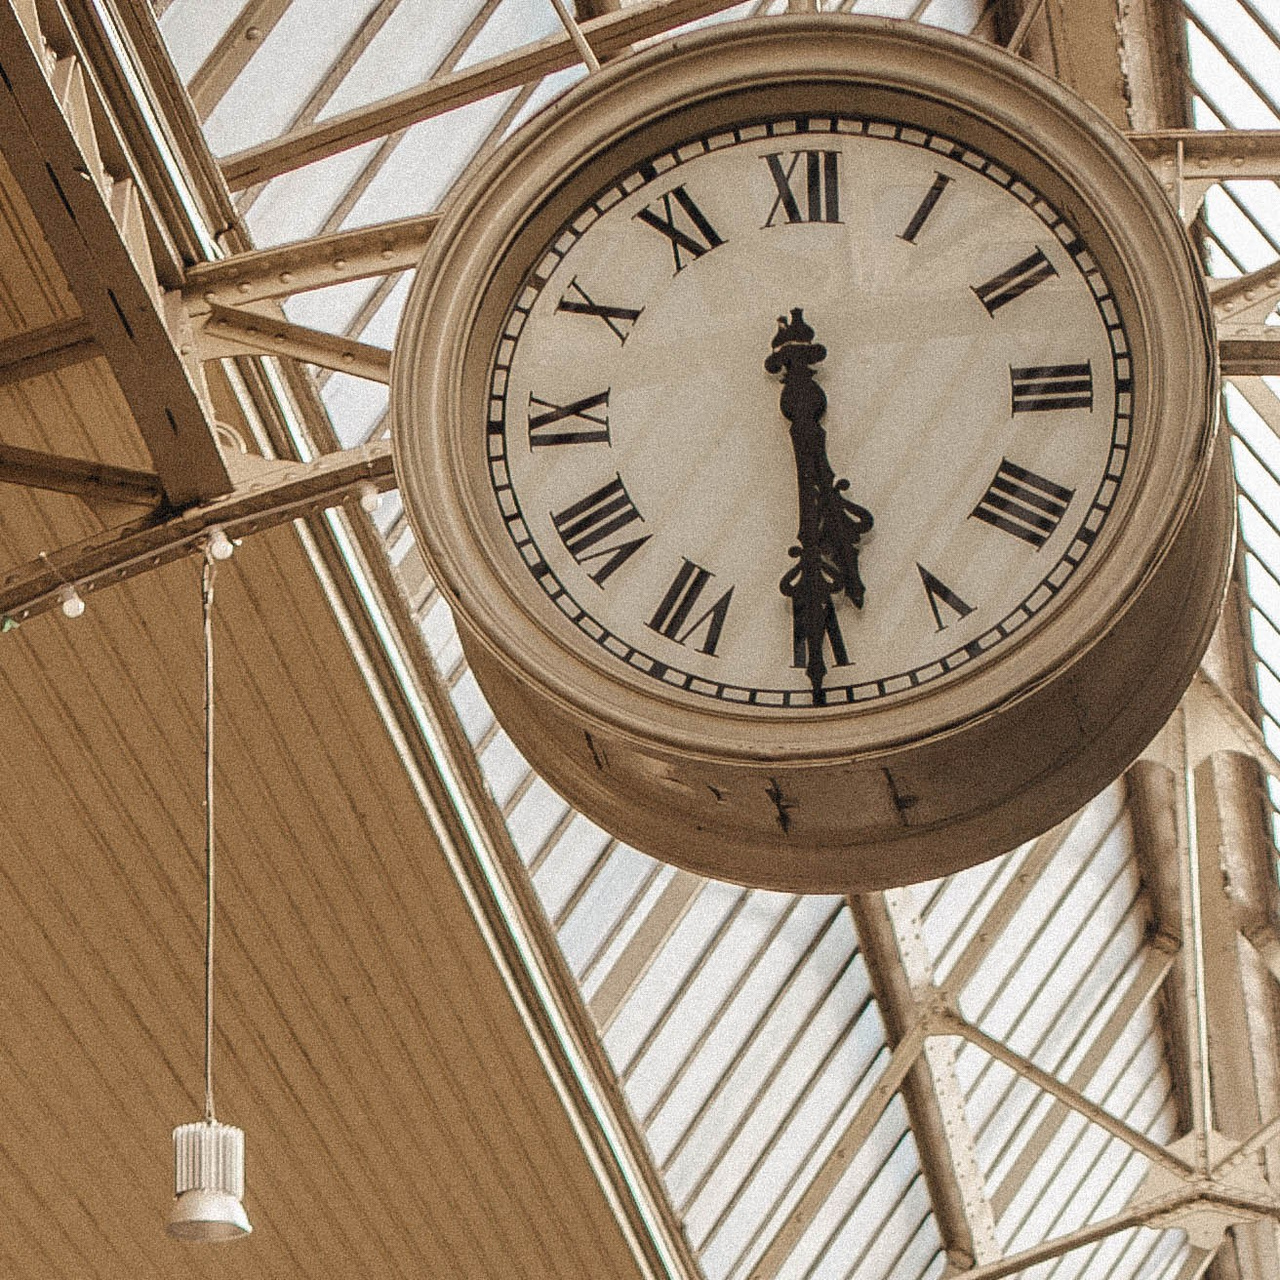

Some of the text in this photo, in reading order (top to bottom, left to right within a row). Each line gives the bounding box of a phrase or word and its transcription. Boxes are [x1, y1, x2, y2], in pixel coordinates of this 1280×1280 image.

[759, 149, 845, 229] XII
[895, 170, 956, 245] I
[631, 183, 729, 277] XI
[555, 275, 645, 347] X
[969, 245, 1060, 319] II
[528, 387, 612, 452] IX
[1009, 358, 1093, 418] III
[549, 472, 653, 590] VIII
[967, 456, 1077, 552] IIII
[645, 557, 735, 658] VII
[916, 562, 978, 633] V
